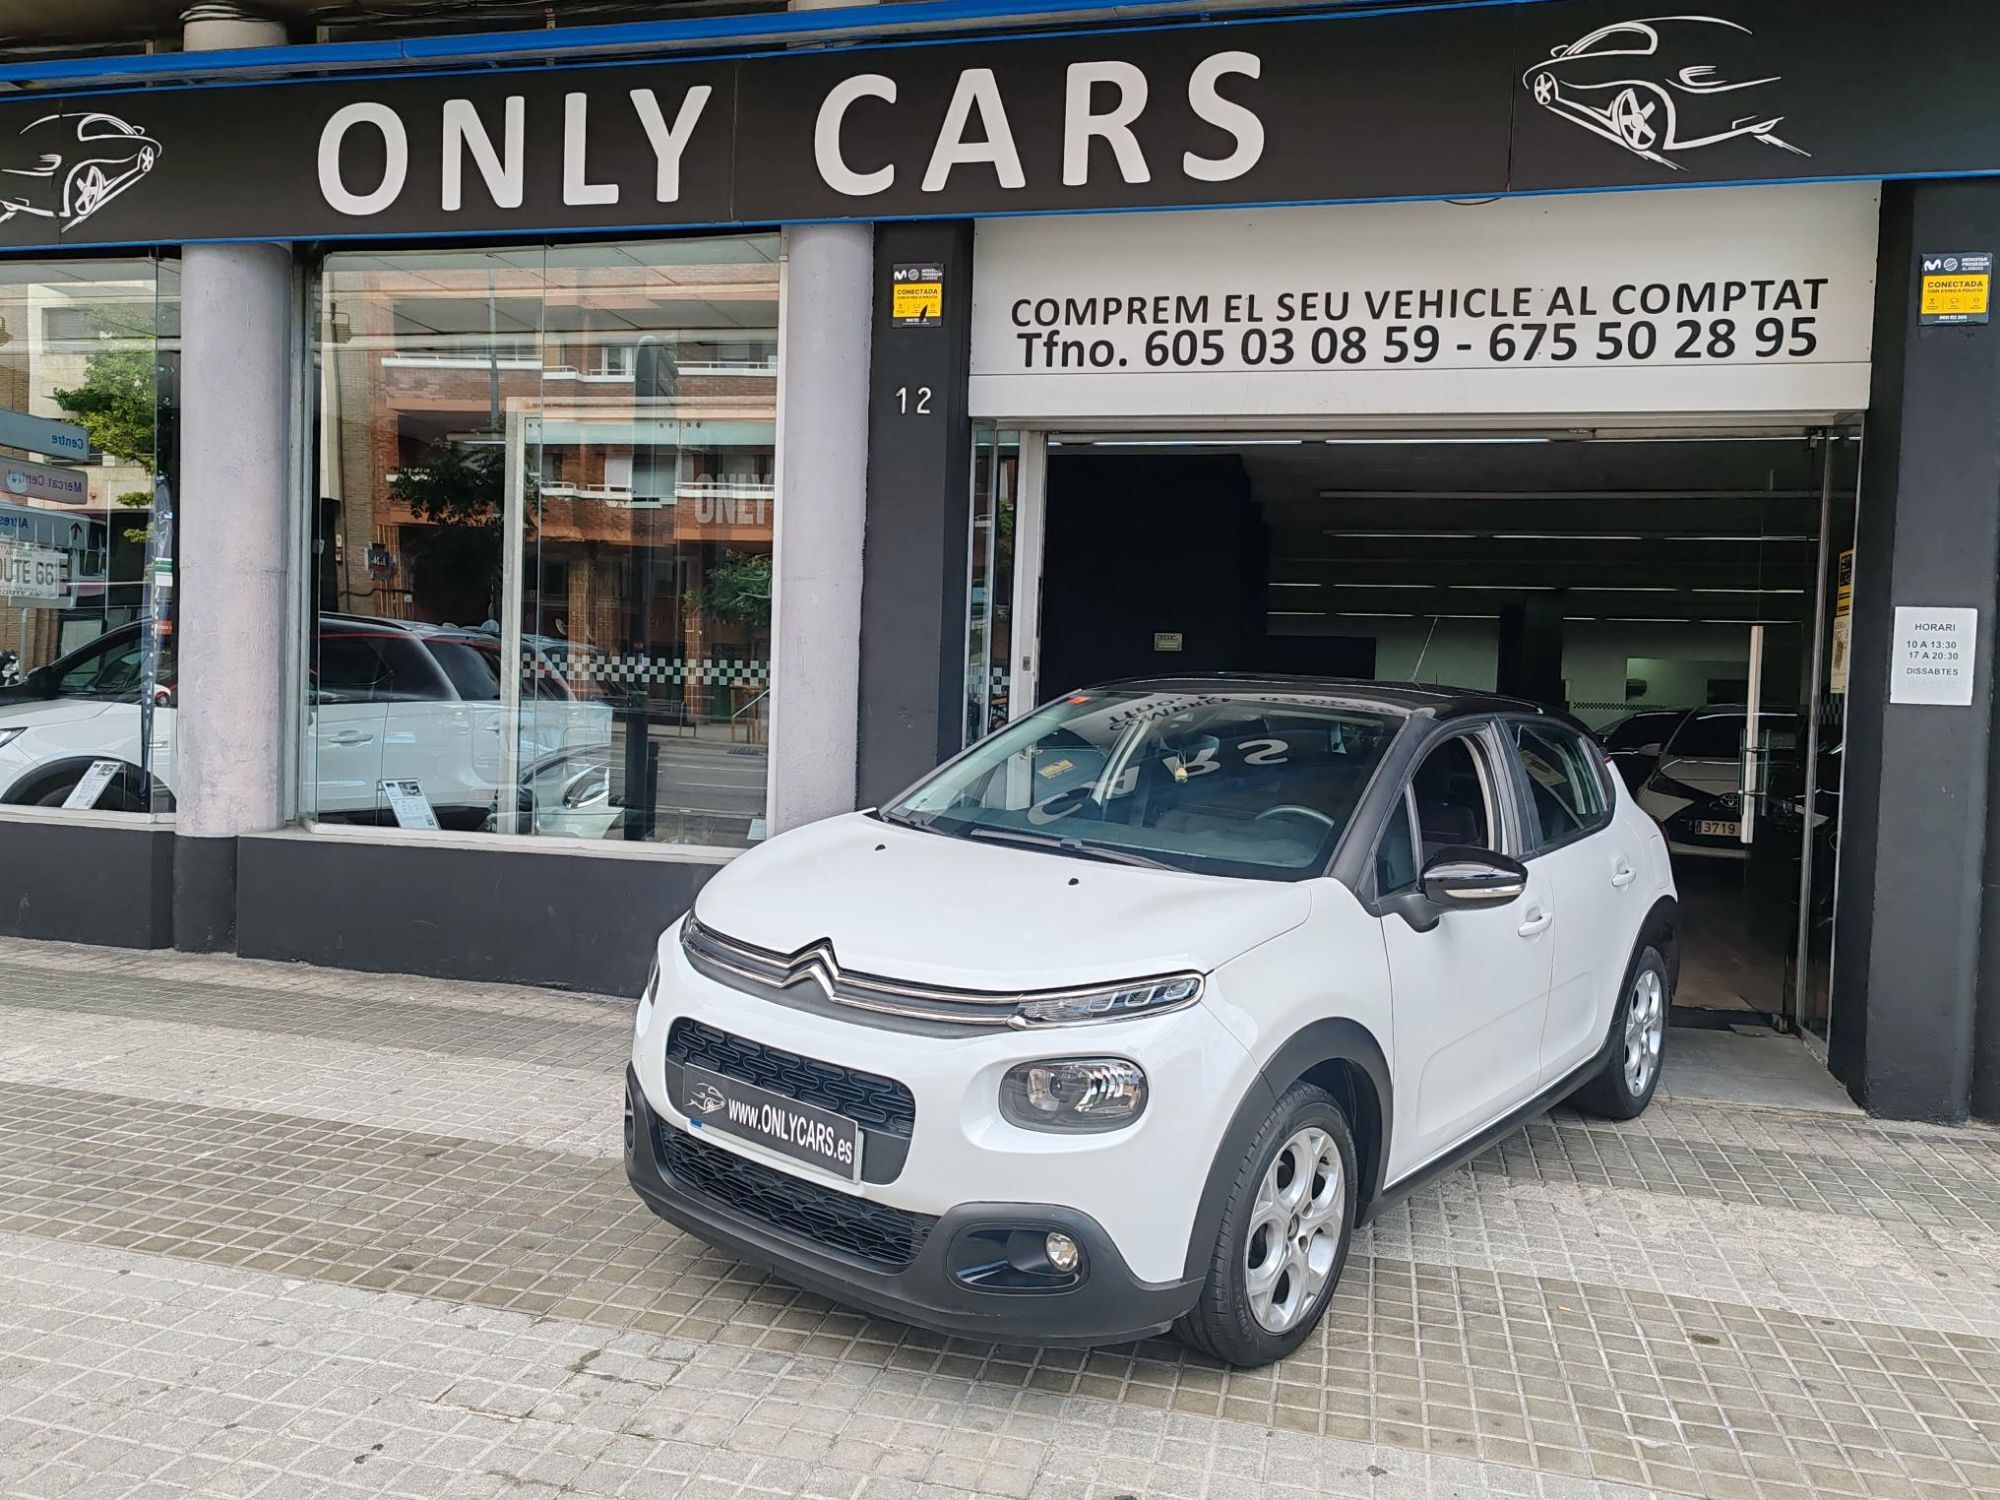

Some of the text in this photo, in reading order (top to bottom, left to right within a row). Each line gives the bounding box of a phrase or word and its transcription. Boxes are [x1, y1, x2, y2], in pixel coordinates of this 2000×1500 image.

[317, 50, 1265, 216] ONLY CARS
[1927, 280, 1984, 288] CONECTADA
[1011, 278, 1829, 327] COMPREM EL SEU VEHICLE AL COMPTAT
[1016, 330, 1128, 368] Tfno.
[1145, 328, 1225, 367] 605
[1240, 327, 1295, 366] 03
[1311, 326, 1367, 365] 08
[1383, 325, 1440, 364] 59
[1489, 322, 1578, 363] 675
[1596, 320, 1657, 360] 50
[1674, 318, 1737, 359] 28
[1755, 316, 1818, 358] 95
[894, 386, 933, 415] 12
[694, 472, 773, 525] ONLY
[36, 561, 54, 586] 66
[1914, 623, 1956, 632] HORARI
[1906, 640, 1957, 649] 10 A 13:30
[1908, 651, 1959, 660] 17 A 20:30
[1906, 667, 1959, 676] DISSABTES
[1703, 821, 1736, 835] 3719
[727, 1097, 853, 1165] www.ONLYCARS.es
